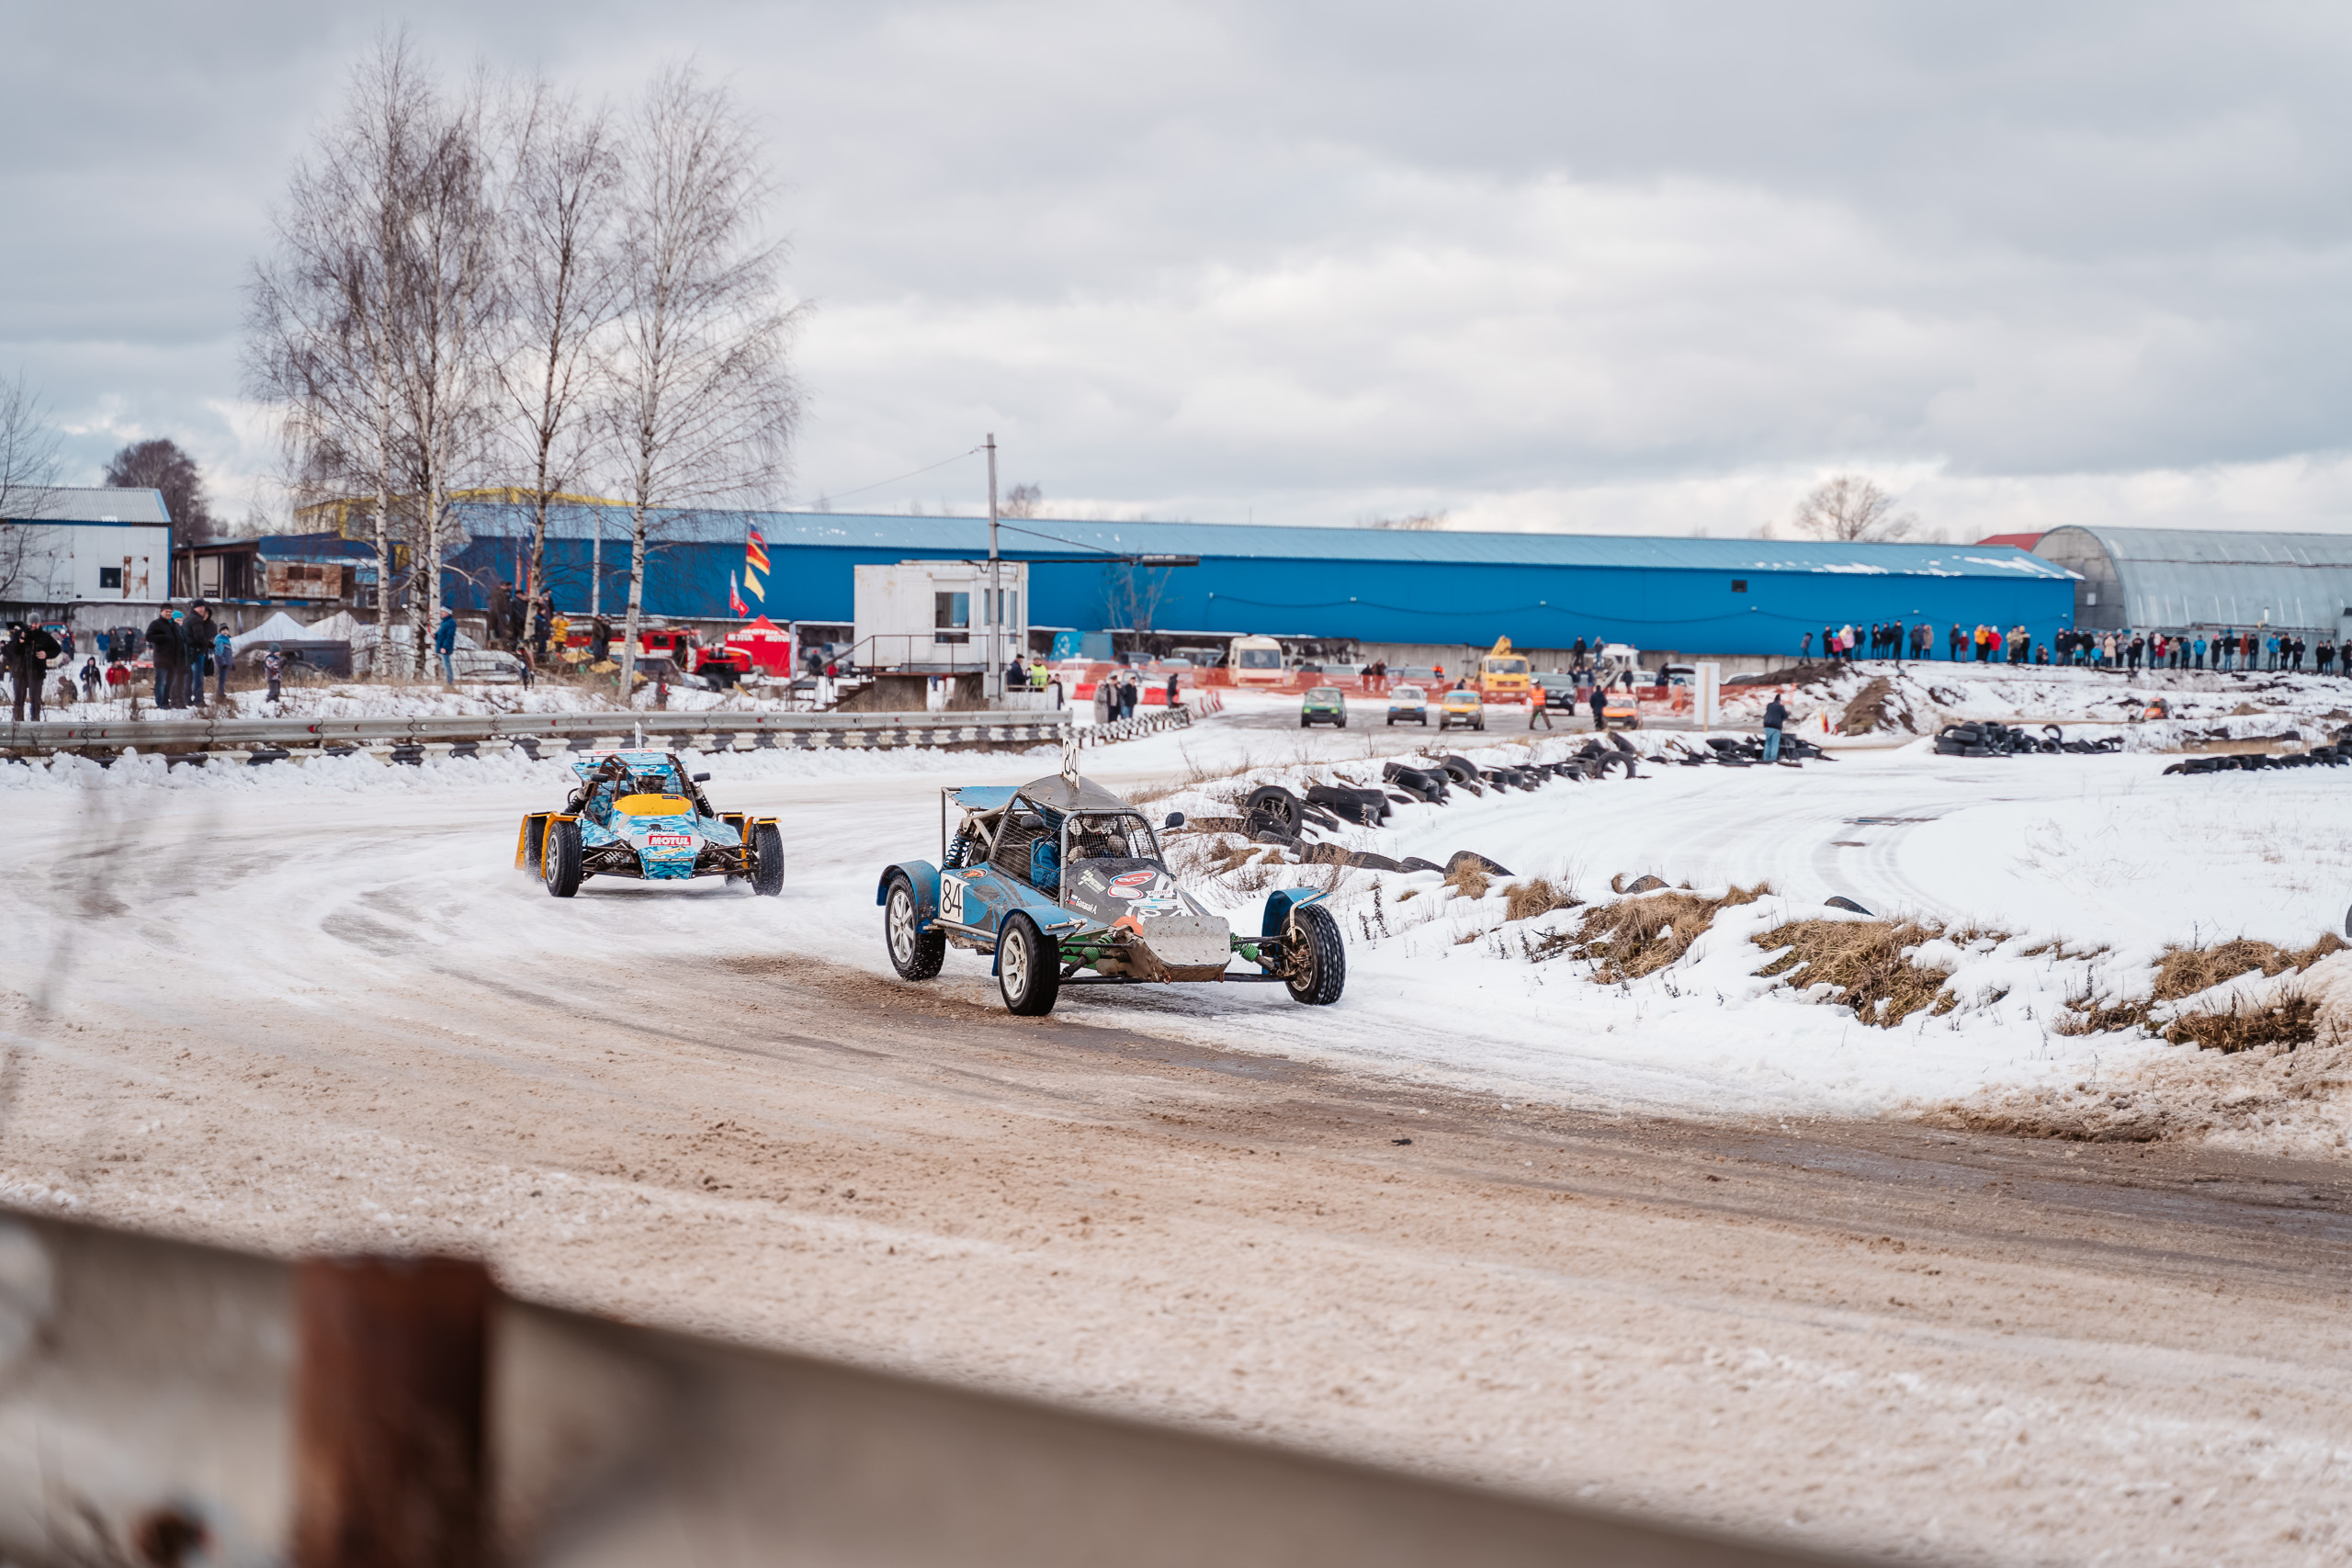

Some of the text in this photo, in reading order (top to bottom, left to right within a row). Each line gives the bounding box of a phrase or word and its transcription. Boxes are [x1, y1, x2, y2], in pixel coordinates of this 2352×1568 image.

[1064, 740, 1078, 782] 84
[650, 836, 690, 845] MOTUL
[942, 878, 962, 918] 84
